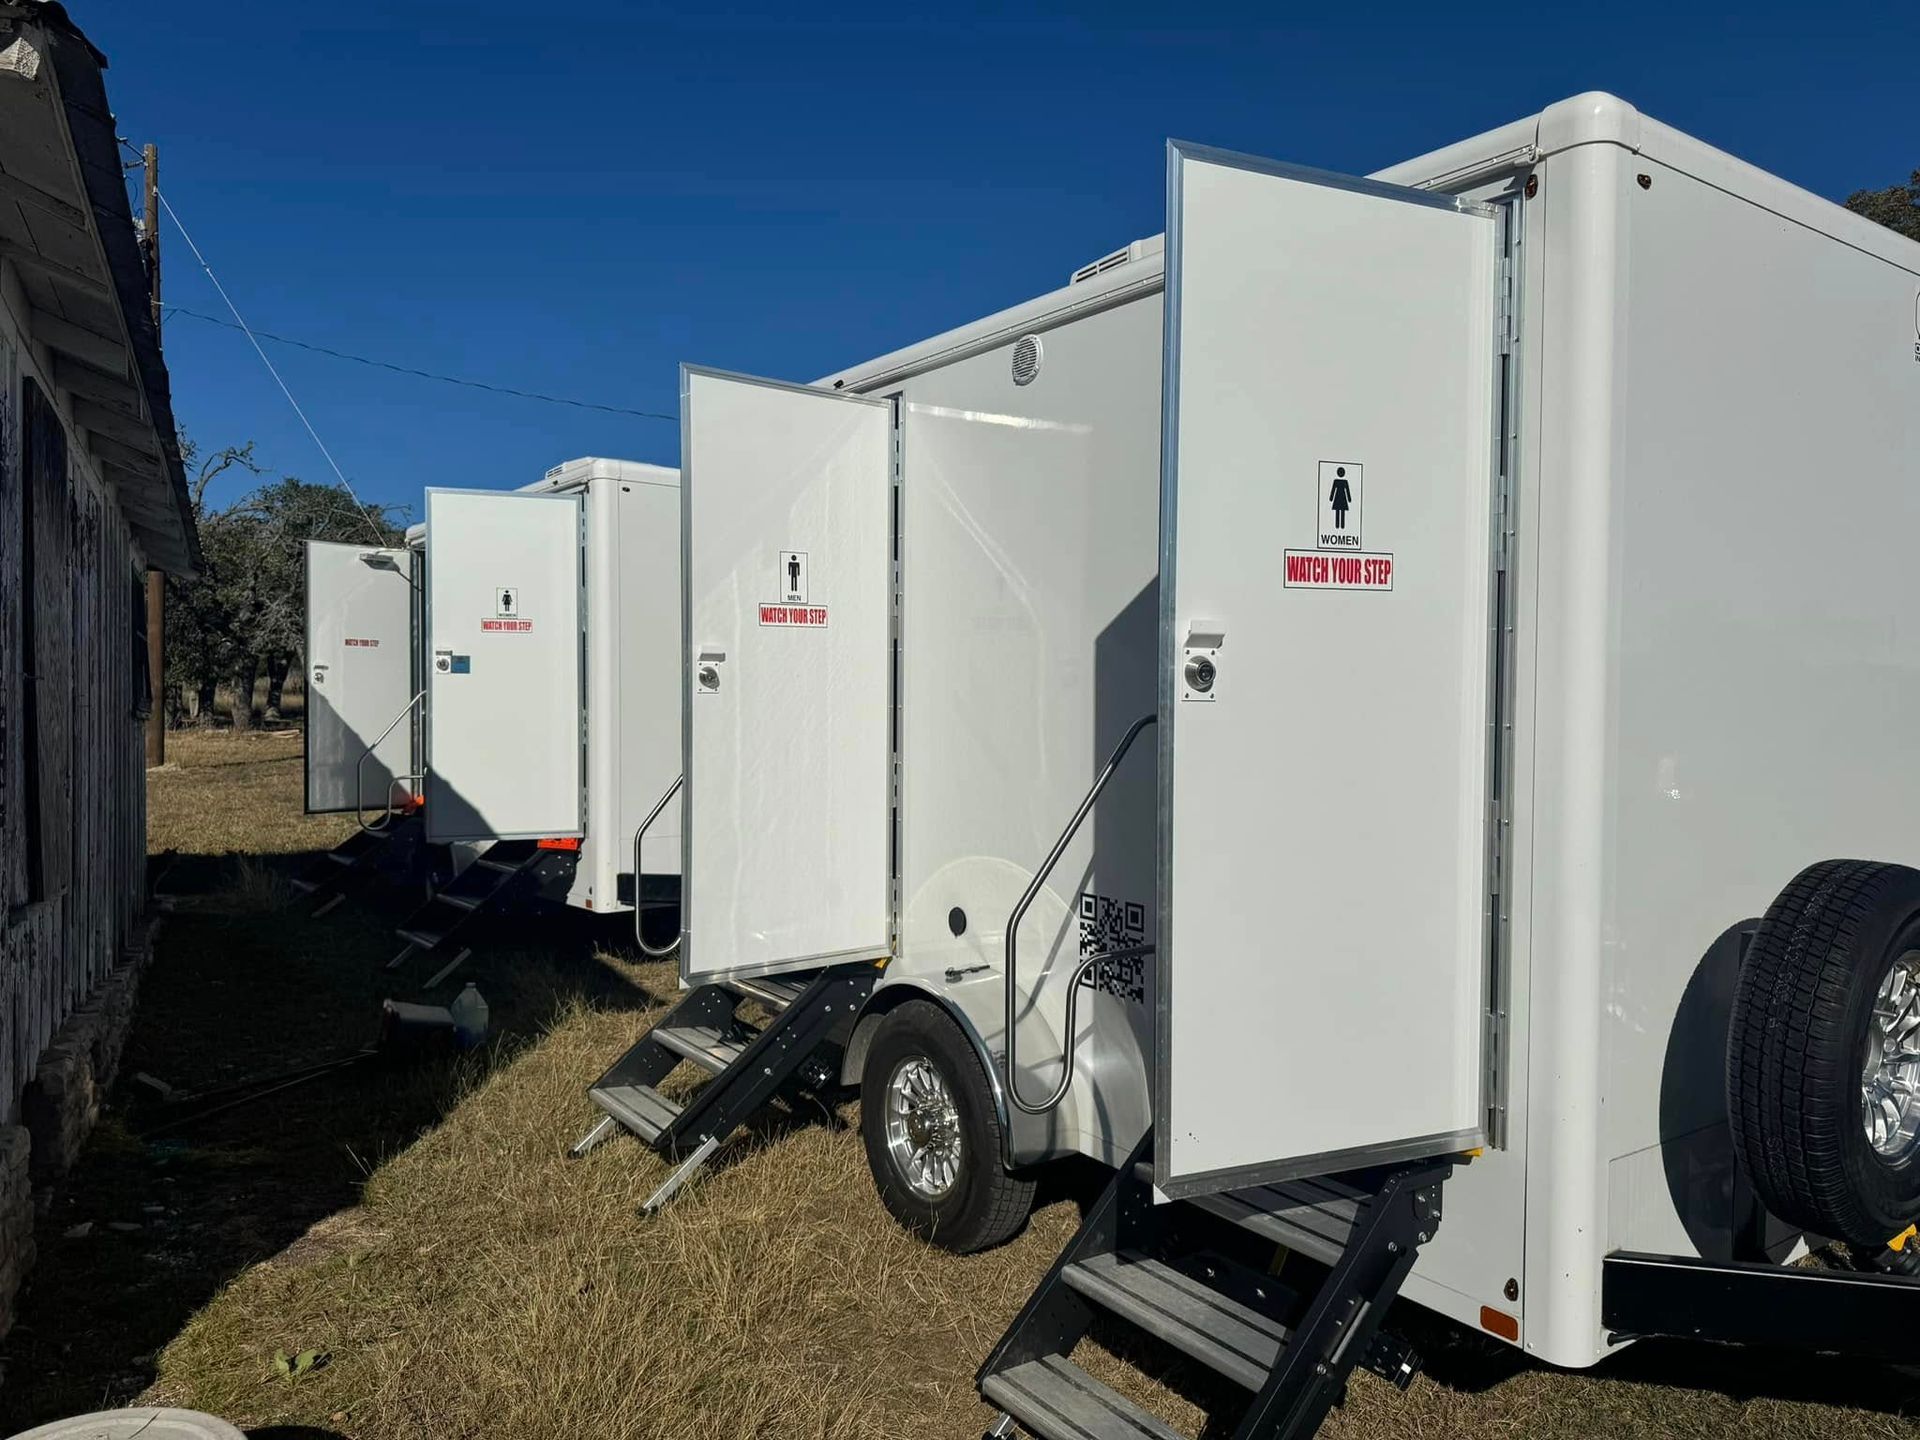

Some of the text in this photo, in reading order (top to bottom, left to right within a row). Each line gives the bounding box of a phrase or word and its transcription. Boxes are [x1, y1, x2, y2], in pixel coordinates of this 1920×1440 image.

[1321, 534, 1359, 546] WOMEN
[1287, 556, 1391, 585] WATCH YOUR STEP
[787, 594, 802, 602] MEN
[761, 606, 827, 624] WATCH YOUR STEP
[518, 621, 532, 631] STEP
